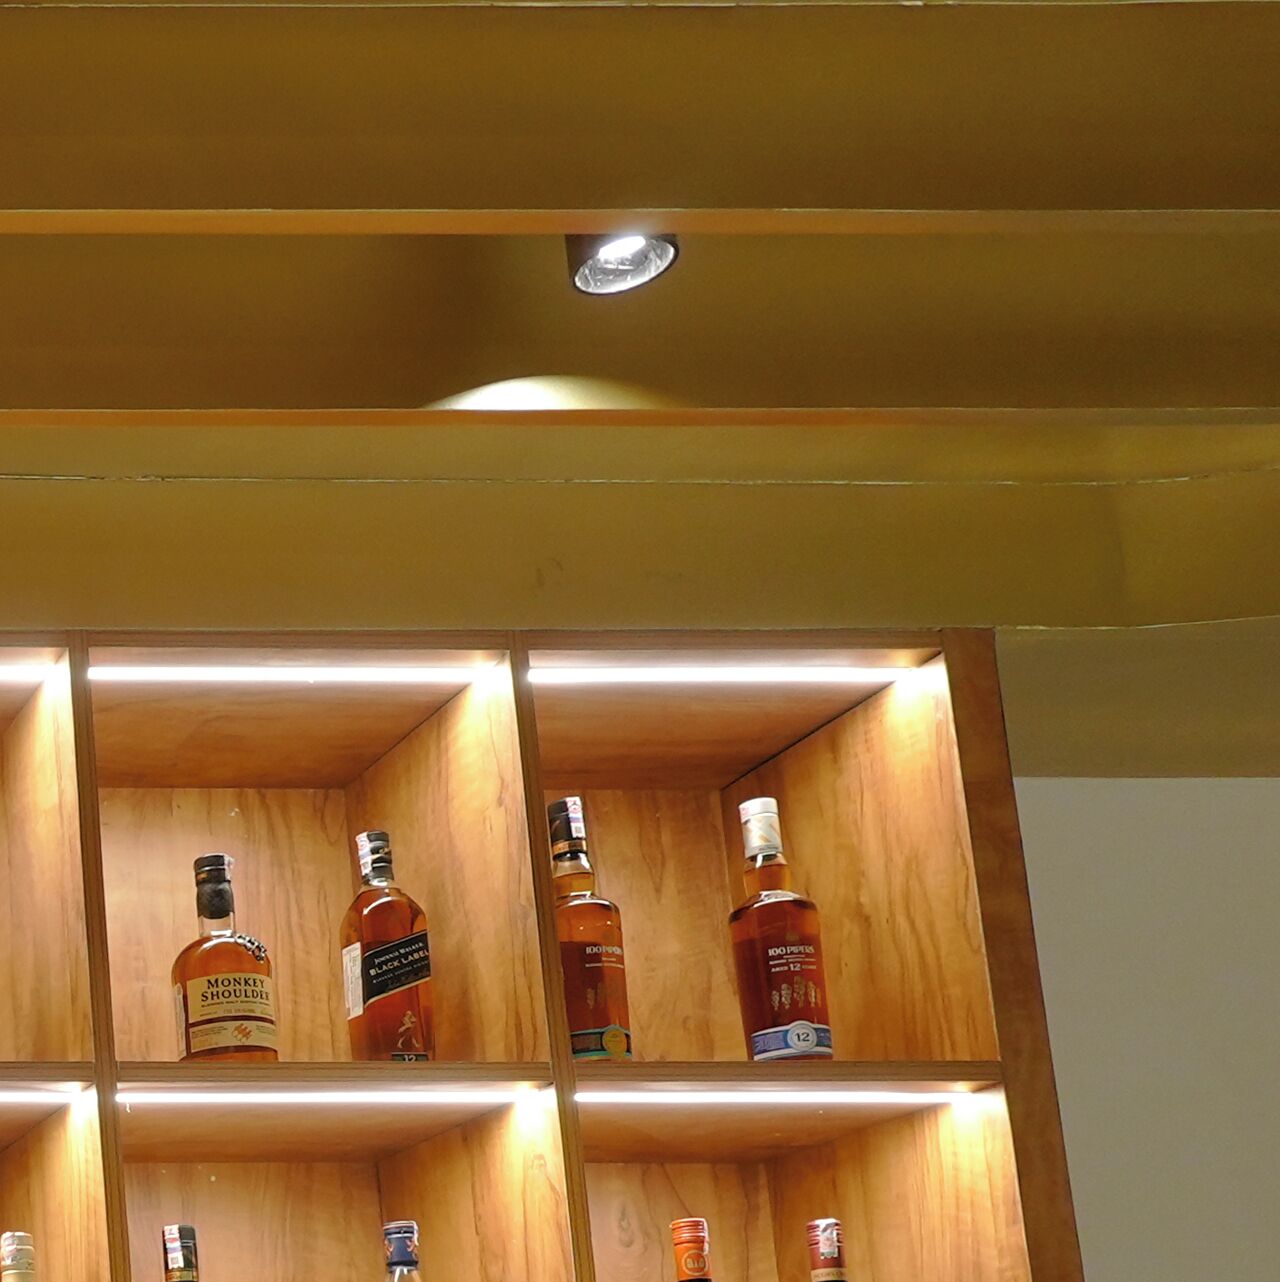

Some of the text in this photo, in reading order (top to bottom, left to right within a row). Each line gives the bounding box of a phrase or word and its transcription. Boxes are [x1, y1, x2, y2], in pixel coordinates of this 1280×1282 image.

[767, 946, 786, 957] 100
[369, 948, 430, 977] BLACK LABEL
[789, 962, 801, 971] 12
[206, 976, 266, 991] MONKEY
[795, 1032, 811, 1043] 12
